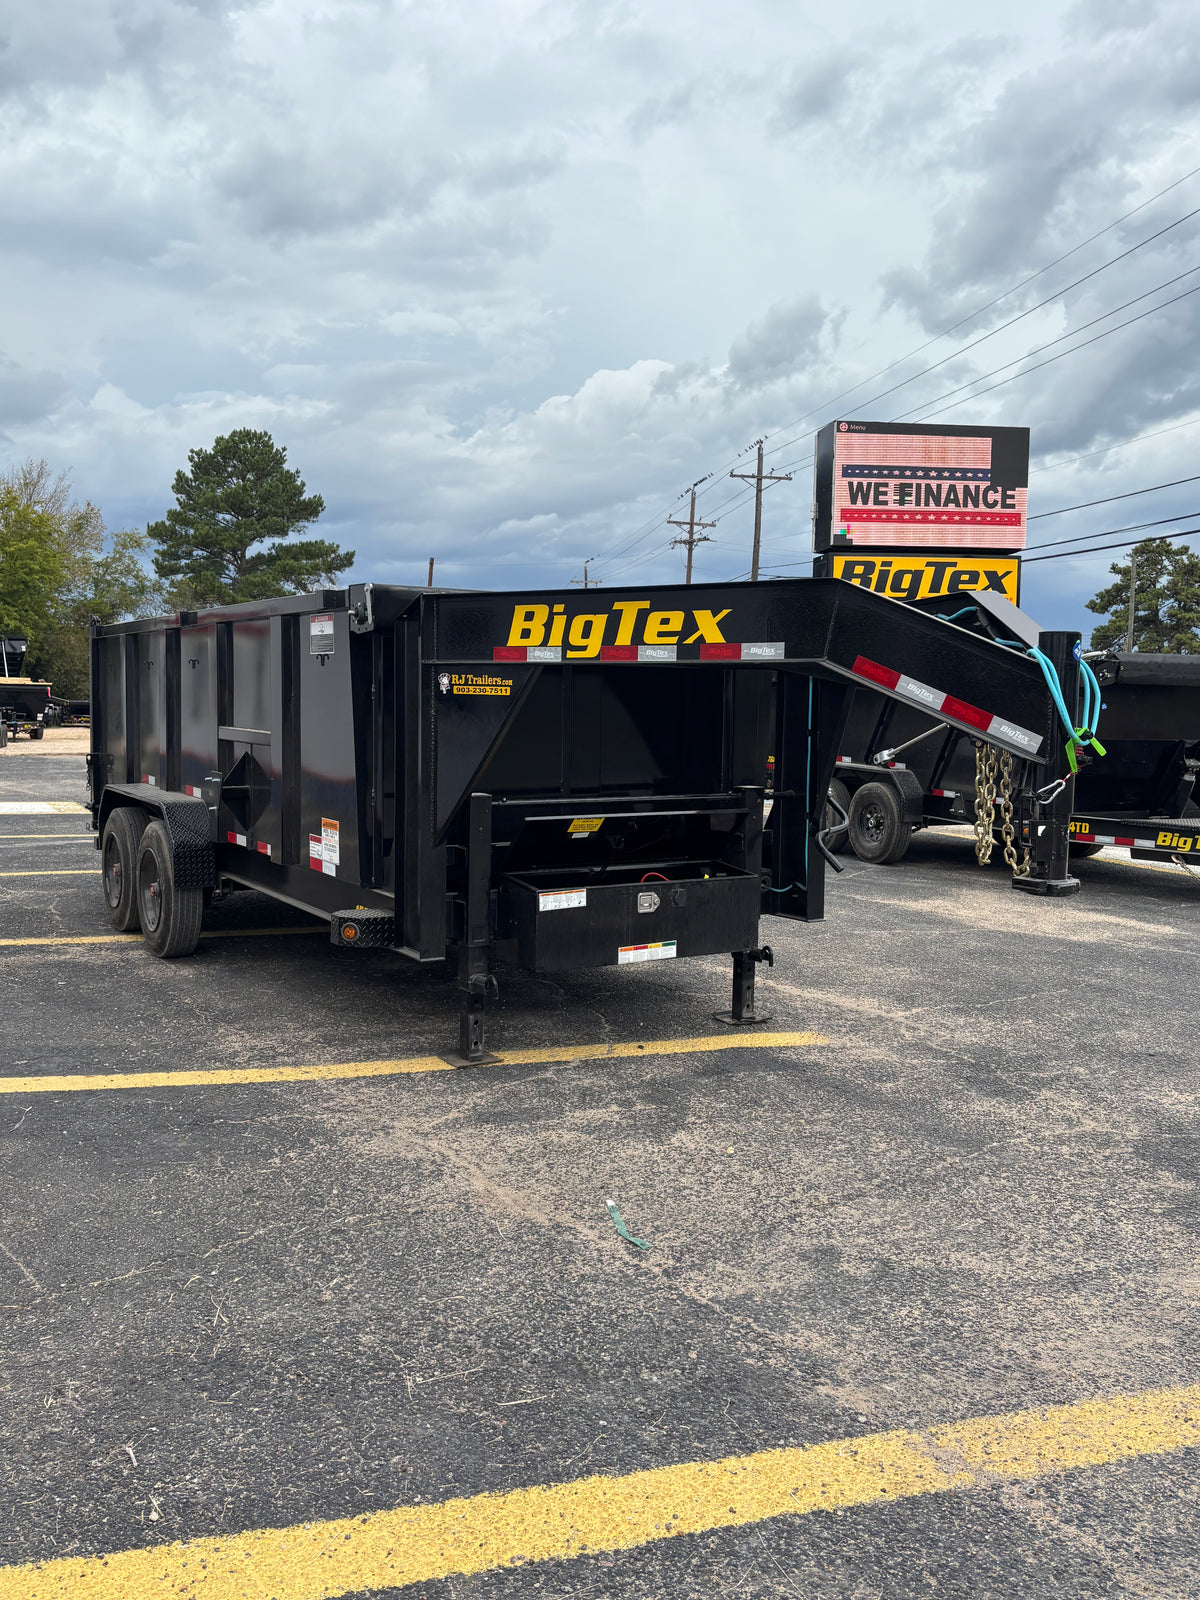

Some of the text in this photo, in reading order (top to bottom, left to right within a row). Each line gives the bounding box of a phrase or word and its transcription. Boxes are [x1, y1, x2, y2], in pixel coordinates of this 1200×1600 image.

[847, 481, 1017, 510] WE FINANCE
[839, 560, 1013, 601] BigTex
[506, 600, 733, 659] BigTex
[750, 646, 776, 655] BigTex
[1000, 725, 1031, 744] BigTex
